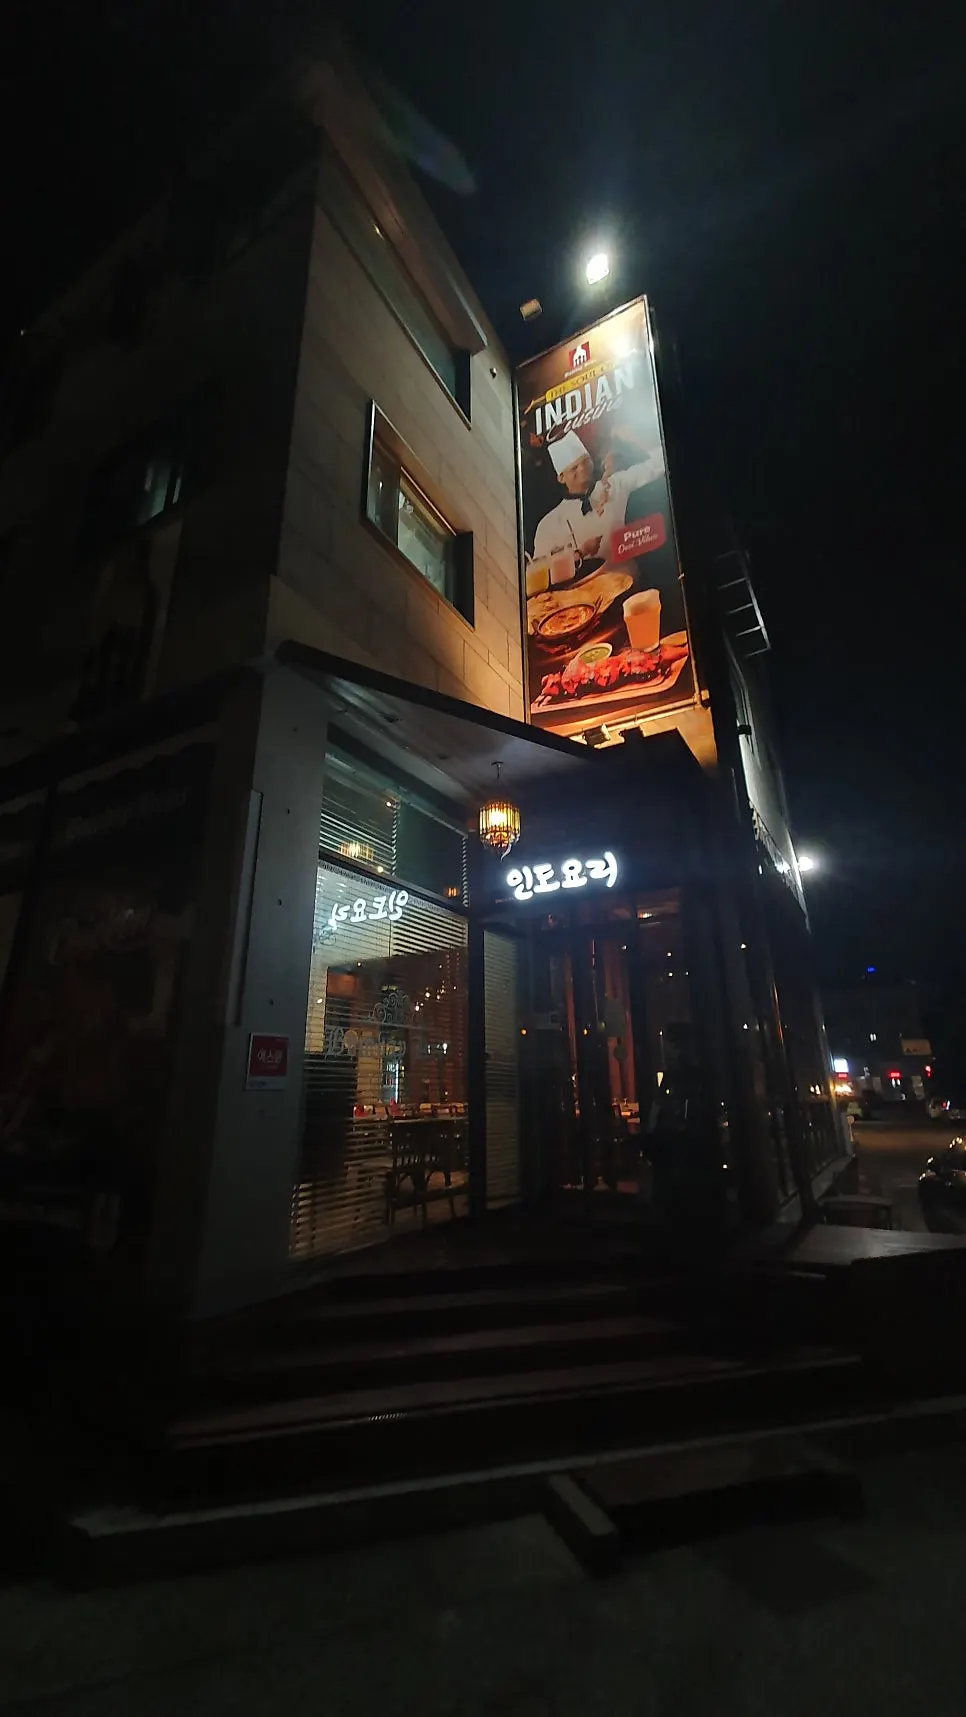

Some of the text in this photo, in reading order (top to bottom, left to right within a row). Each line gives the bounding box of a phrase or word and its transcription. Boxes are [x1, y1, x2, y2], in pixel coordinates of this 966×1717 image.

[534, 364, 635, 436] INDIAN
[623, 525, 651, 542] Pure
[506, 850, 618, 901] 인도요리
